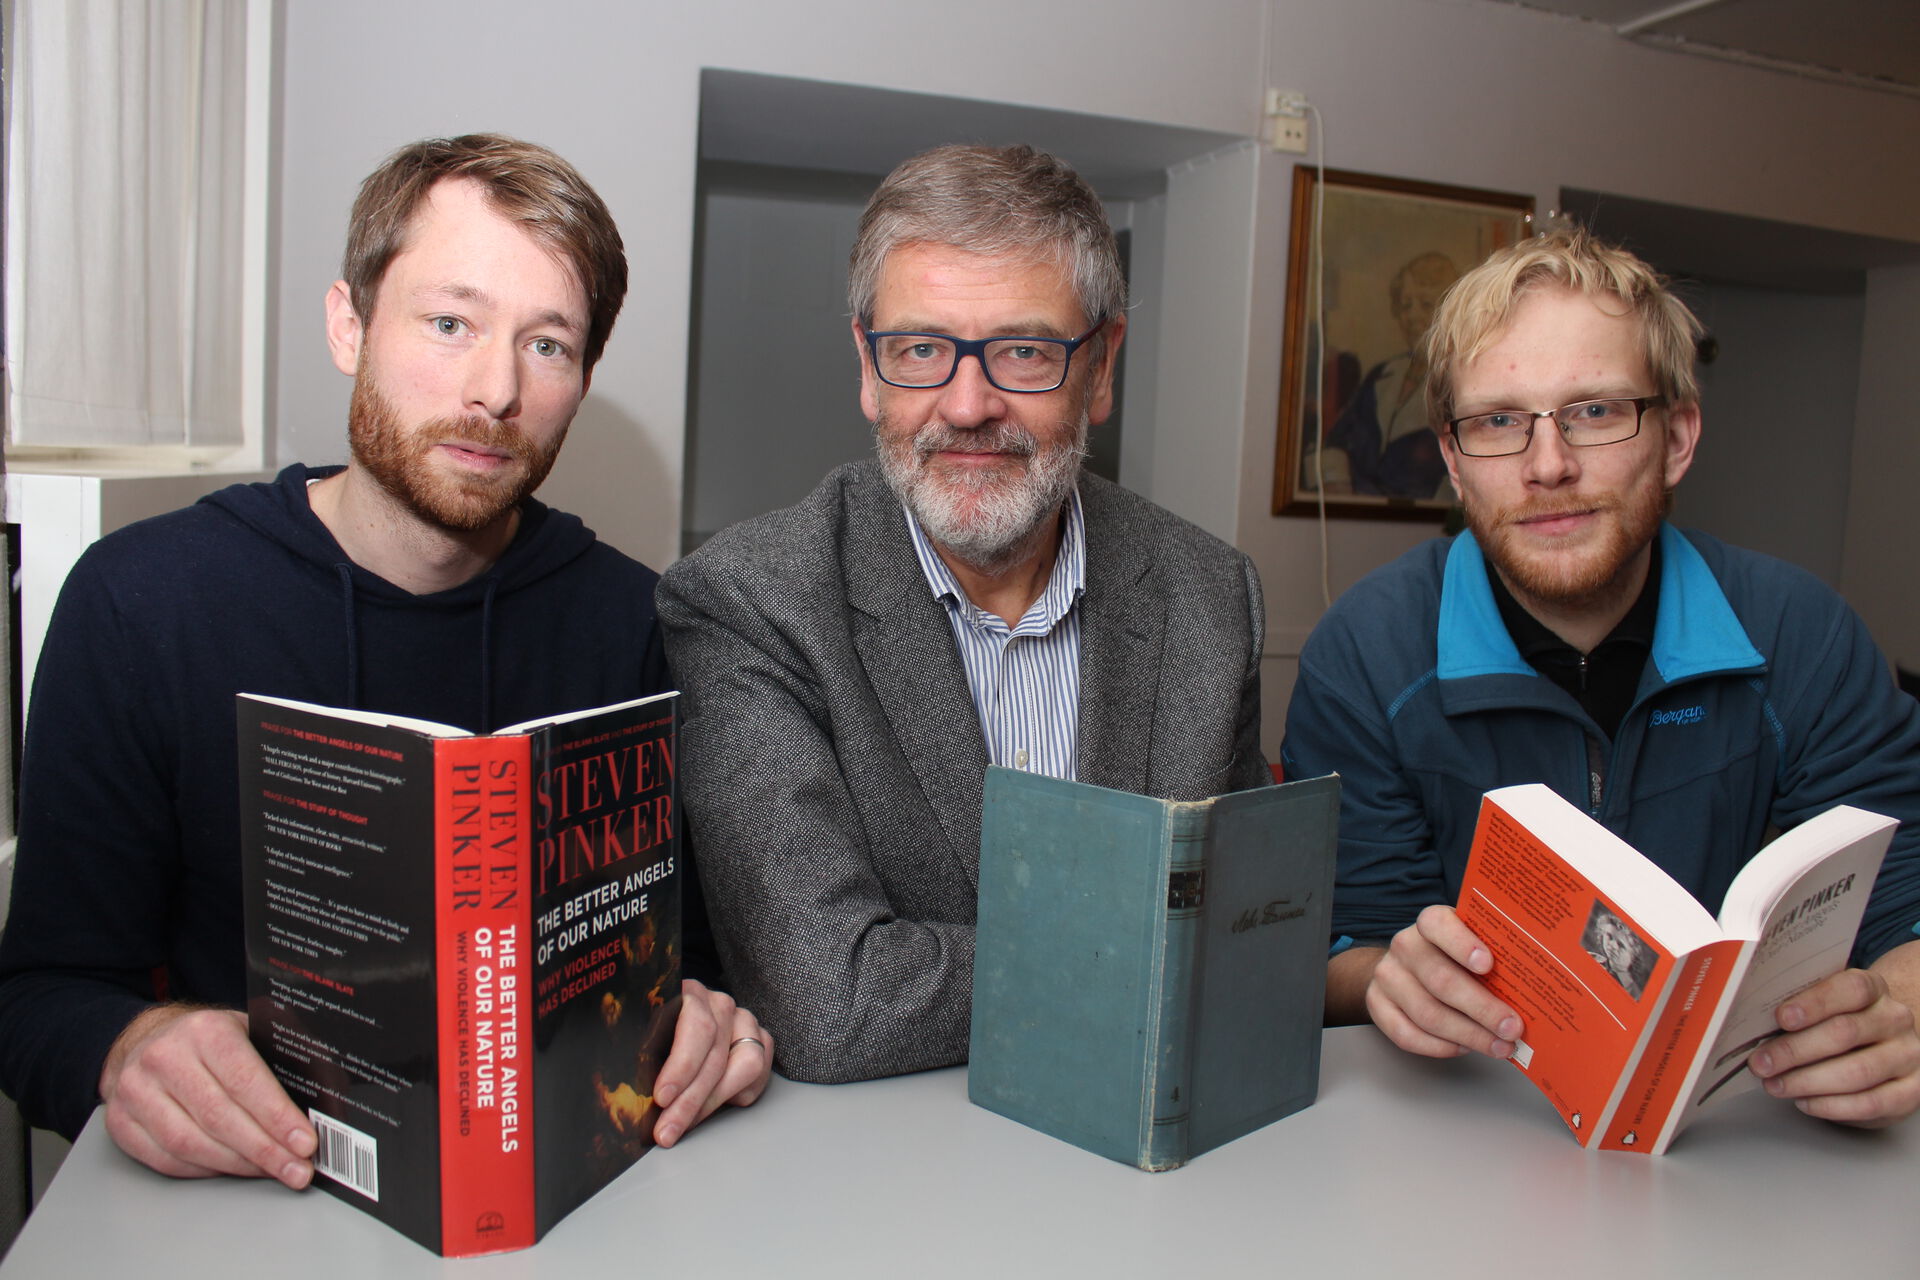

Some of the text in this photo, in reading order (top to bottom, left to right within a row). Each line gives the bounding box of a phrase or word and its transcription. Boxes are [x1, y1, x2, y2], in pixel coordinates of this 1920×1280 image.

[536, 733, 677, 830] STEVEN
[453, 765, 481, 912] PINKER
[490, 760, 518, 910] STEVEN
[536, 795, 675, 897] PINKER
[537, 857, 674, 938] THE BETTER ANGELS
[538, 893, 648, 965] OF OUR NATURE
[1798, 873, 1857, 919] PINKER
[538, 938, 621, 997] WHY VIOLENCE
[538, 961, 616, 1020] HAS DECLINED
[1683, 957, 1712, 1011] STEVEN PINKER
[456, 931, 471, 1137] WHY VIOLENCE HAS DECLINED
[474, 927, 495, 1109] OF OUR NATURE
[499, 924, 519, 1153] THE BETTER ANGELS
[1170, 1086, 1180, 1103] 4
